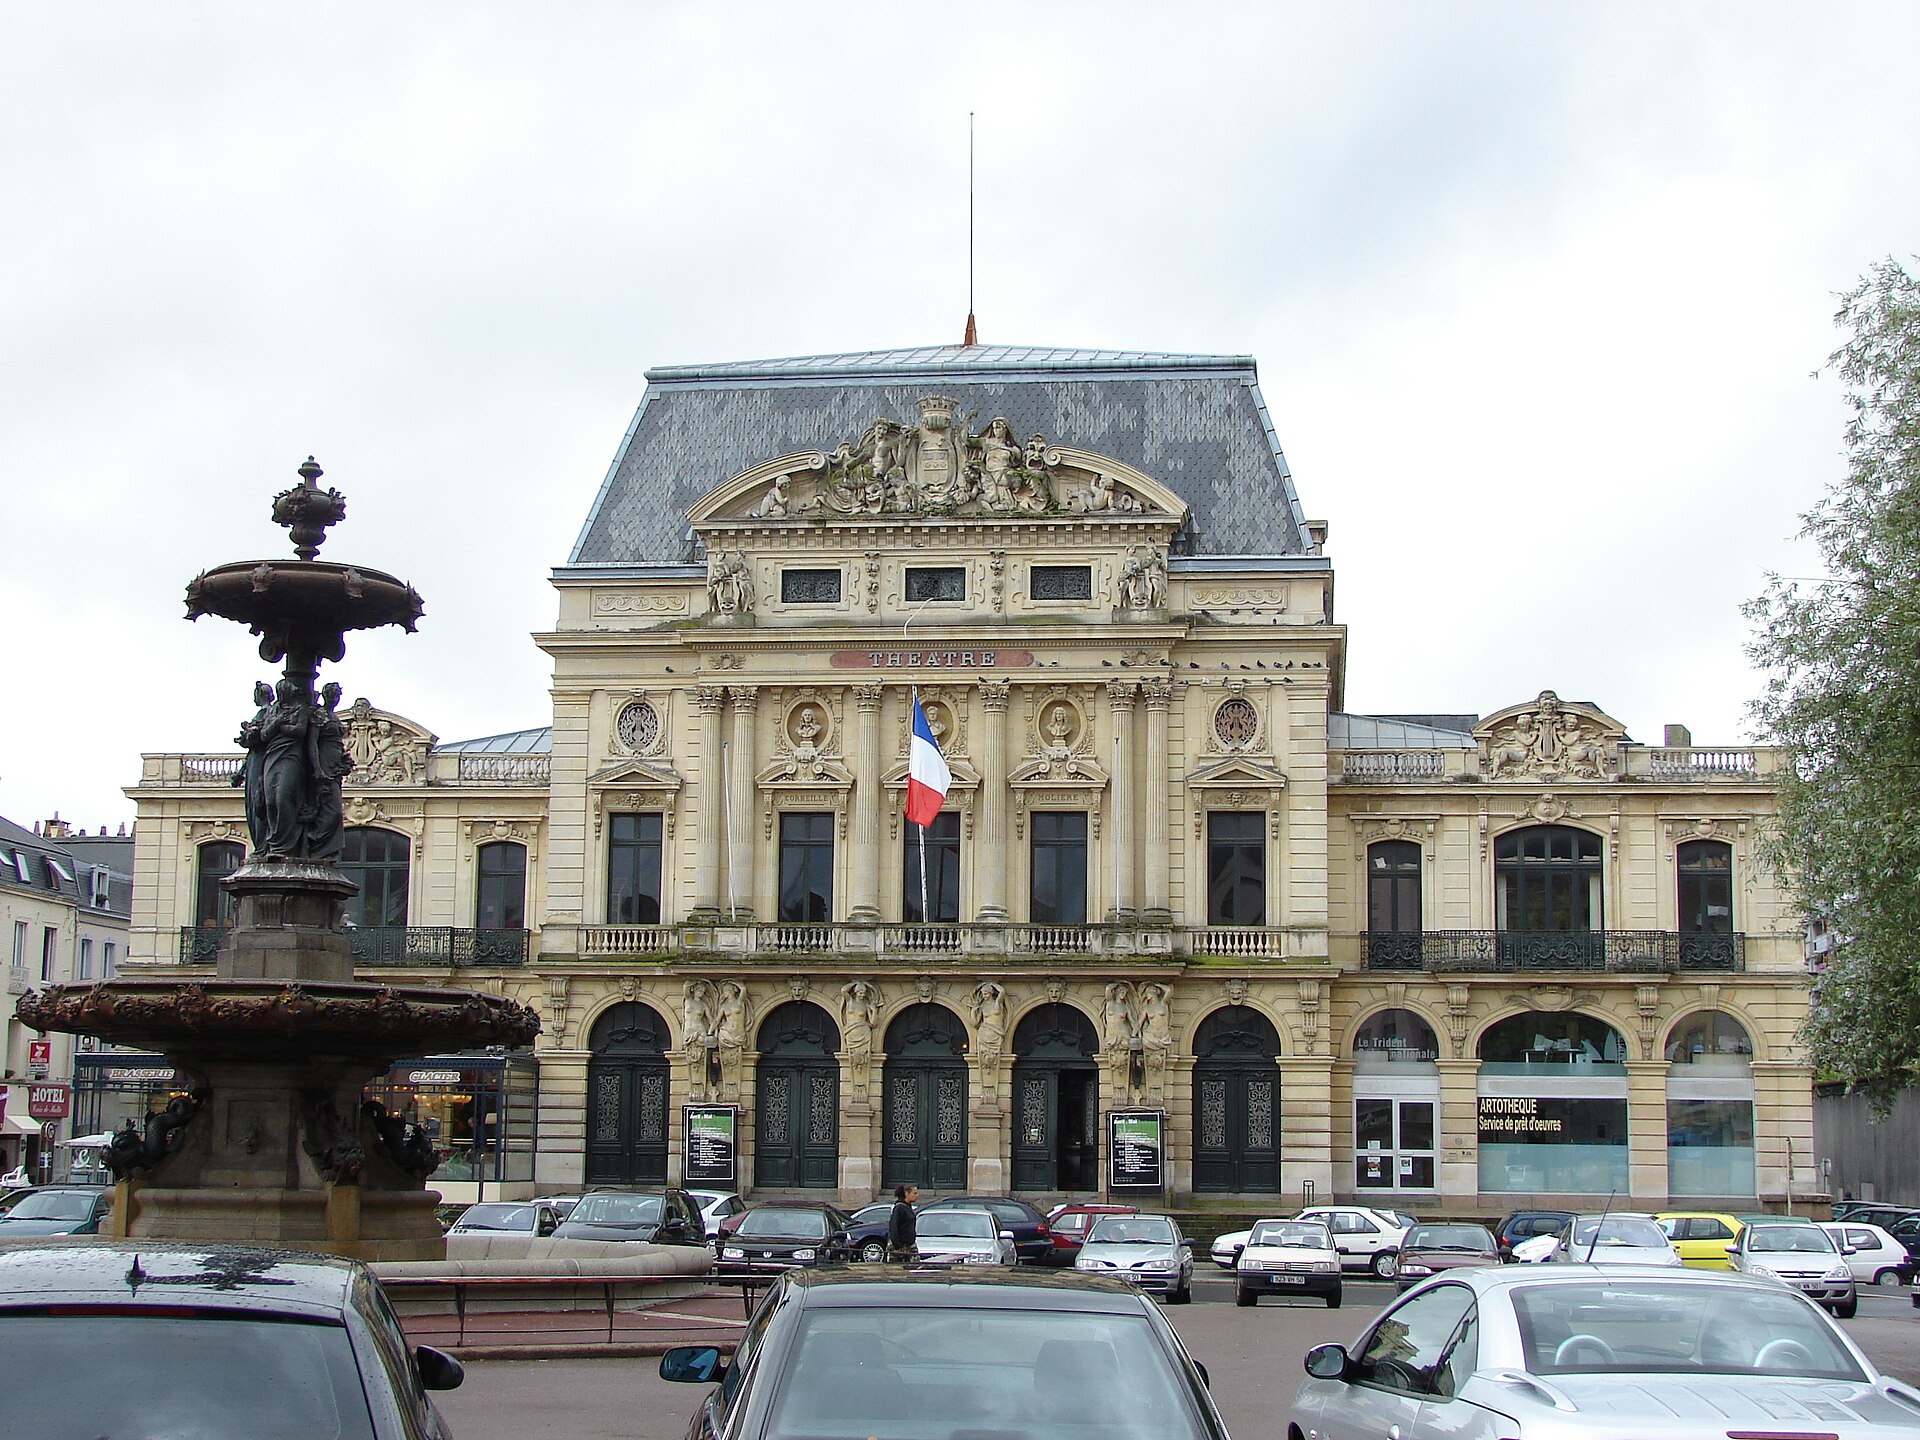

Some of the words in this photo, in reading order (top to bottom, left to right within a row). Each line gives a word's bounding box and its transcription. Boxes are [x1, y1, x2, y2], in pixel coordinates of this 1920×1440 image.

[868, 651, 996, 667] THEATRE
[1358, 1037, 1368, 1047] Le
[1372, 1037, 1407, 1047] Trident
[1391, 1048, 1436, 1059] nationale
[111, 1069, 175, 1079] BRASSERIE
[410, 1072, 460, 1082] GLACIER
[32, 1087, 65, 1103] HOTEL
[1479, 1098, 1537, 1114] ARTOTHEQUE
[1478, 1115, 1504, 1131] Service
[1504, 1116, 1513, 1131] de
[1514, 1116, 1529, 1134] prêt
